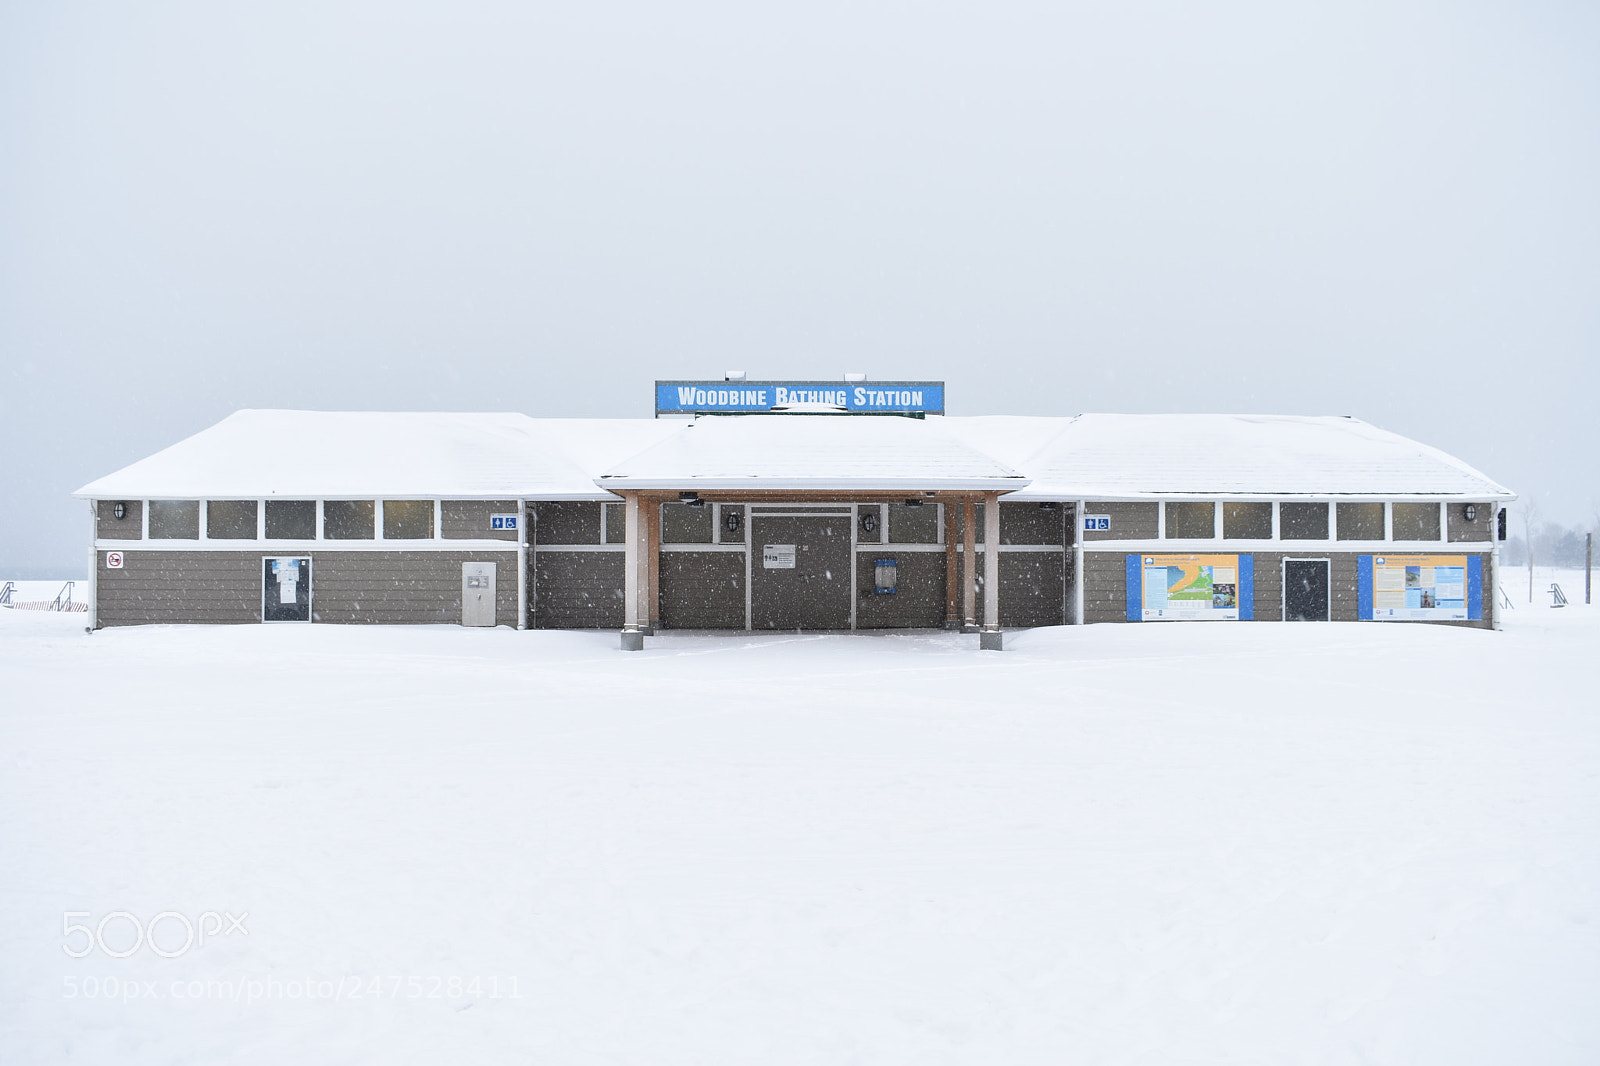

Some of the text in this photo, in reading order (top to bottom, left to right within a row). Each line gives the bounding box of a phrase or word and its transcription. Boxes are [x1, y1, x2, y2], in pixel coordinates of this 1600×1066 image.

[677, 386, 923, 407] WOODBINE BATHING STATION
